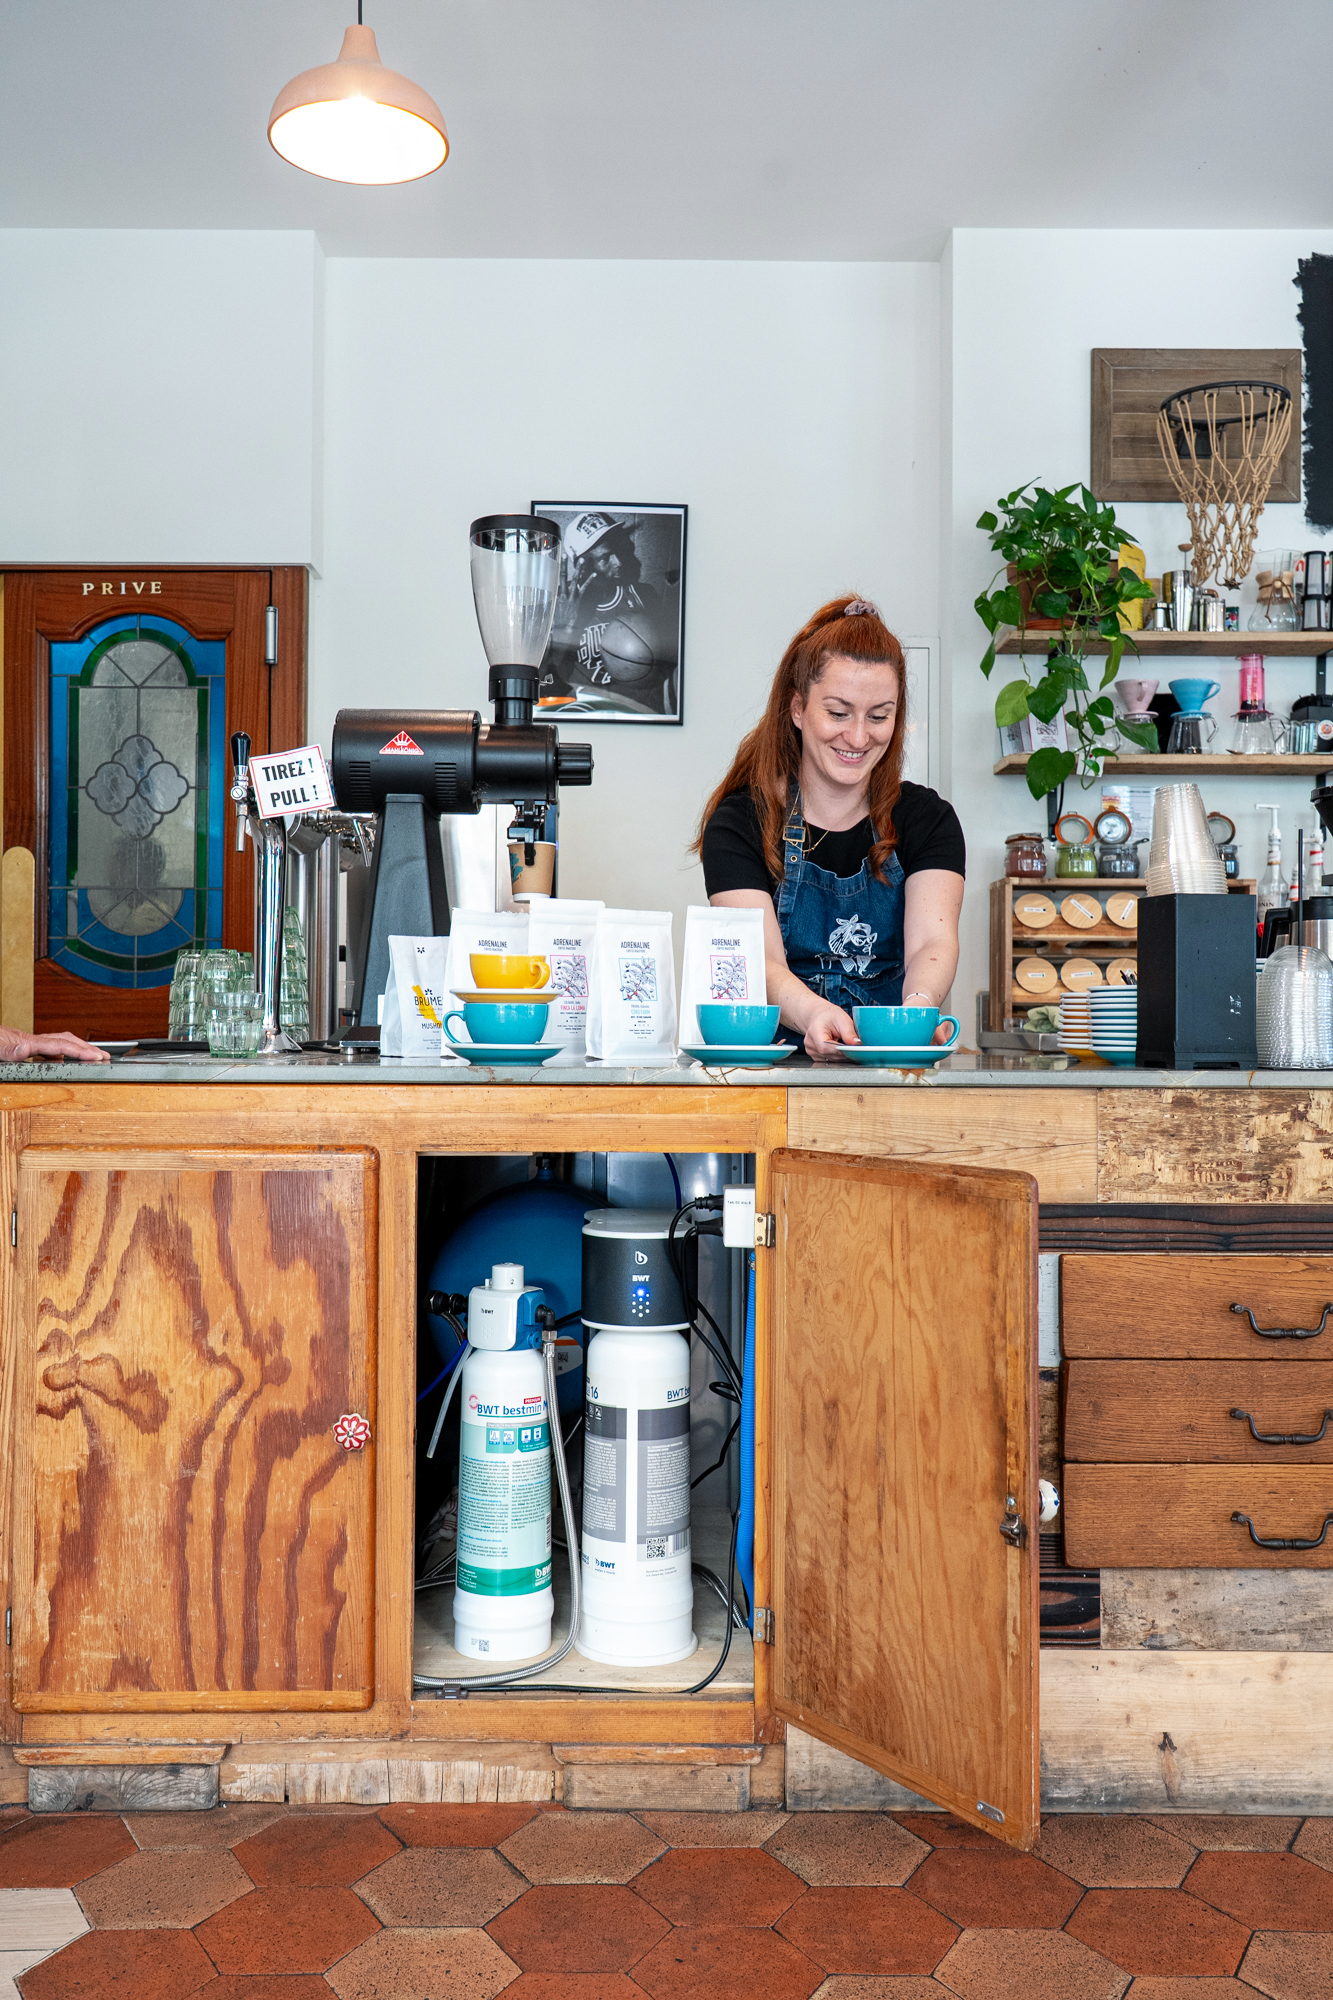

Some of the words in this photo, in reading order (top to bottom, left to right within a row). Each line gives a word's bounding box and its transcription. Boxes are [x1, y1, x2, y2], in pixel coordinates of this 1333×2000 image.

[82, 581, 161, 596] PRIVE
[262, 760, 305, 782] TIREZ
[308, 758, 314, 773] !
[270, 788, 310, 808] PULL
[312, 785, 319, 800] !
[478, 939, 508, 948] ADRENALINE
[552, 938, 582, 947] ADRENALINE
[620, 941, 650, 949] ADRENALINE
[711, 938, 741, 946] ADRENALINE
[414, 996, 443, 1006] BRUME
[632, 1274, 650, 1282] BWT
[591, 1386, 599, 1399] 16
[667, 1387, 684, 1400] BWT
[477, 1404, 499, 1415] BWT
[503, 1403, 541, 1415] bestmin
[600, 1560, 616, 1569] BWT
